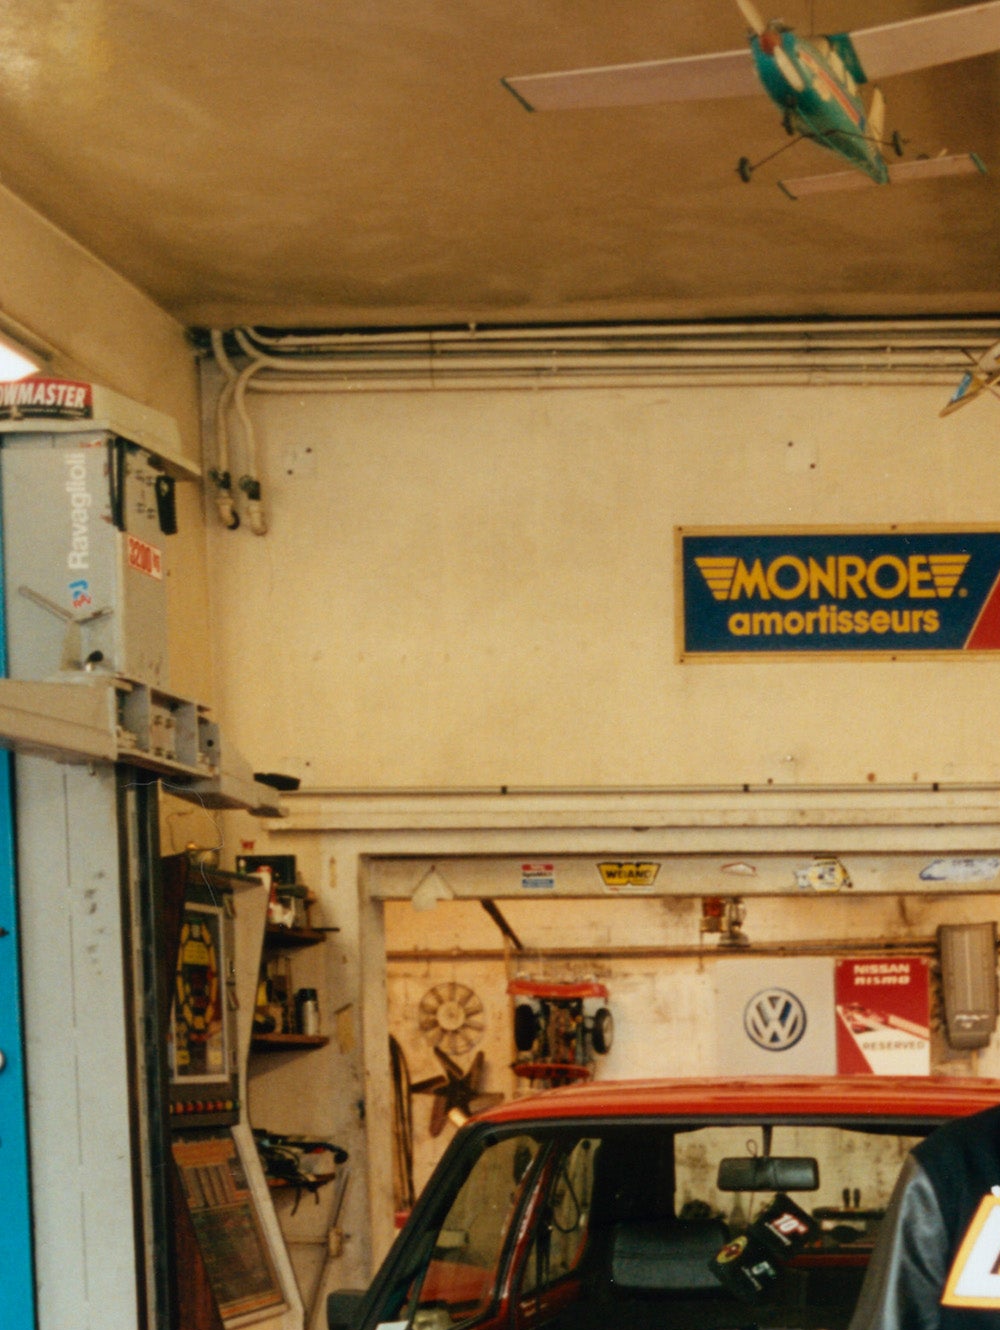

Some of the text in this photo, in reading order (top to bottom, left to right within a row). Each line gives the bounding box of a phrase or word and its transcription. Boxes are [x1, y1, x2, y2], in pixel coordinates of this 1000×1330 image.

[0, 382, 86, 408] WMASTER
[66, 453, 91, 570] Ravaglioli
[728, 554, 942, 600] MONROE
[728, 605, 940, 636] amortisseurs
[853, 963, 911, 975] NISSAN
[862, 1041, 925, 1050] RESERVED
